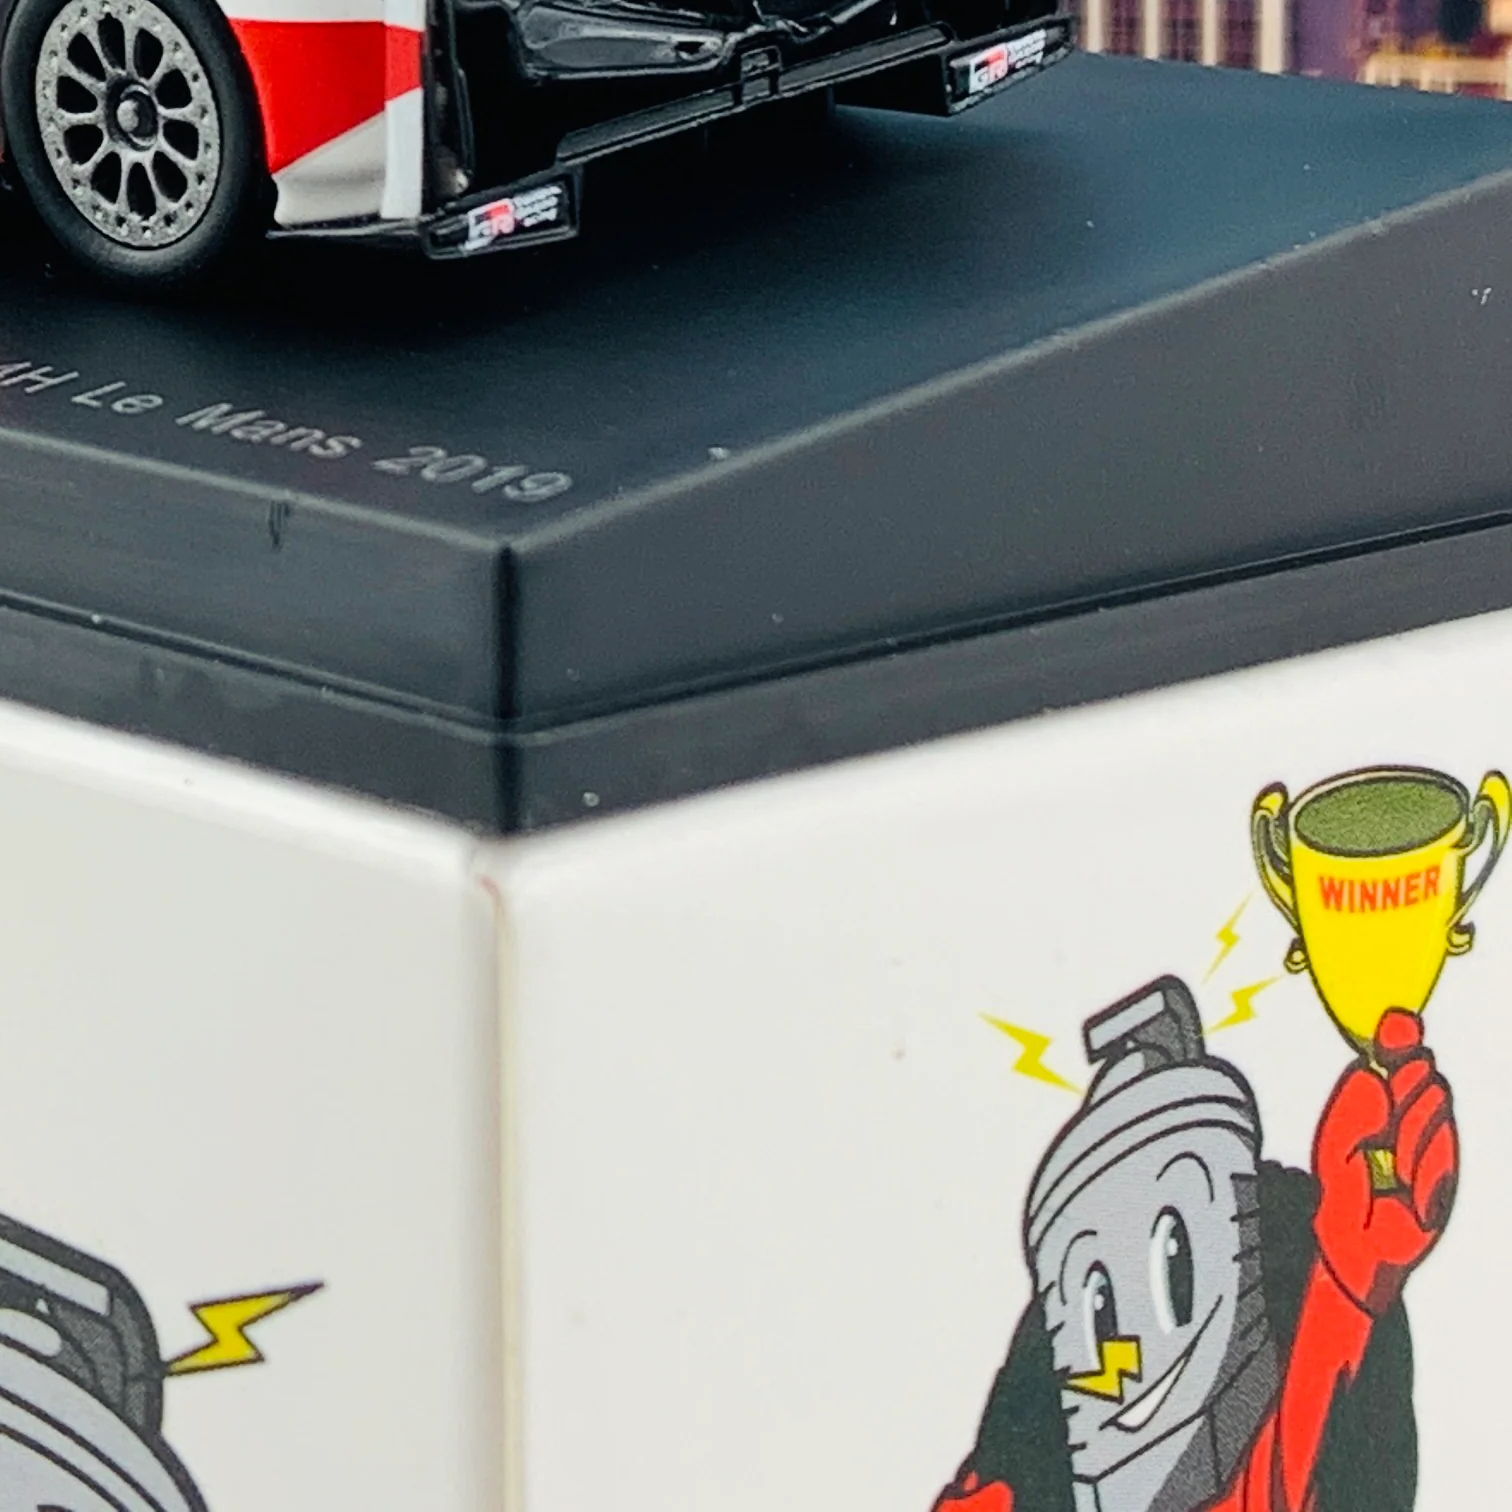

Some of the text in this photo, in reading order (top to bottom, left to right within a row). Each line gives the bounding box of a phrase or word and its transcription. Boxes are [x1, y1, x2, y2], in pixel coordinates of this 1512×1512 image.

[70, 380, 165, 415] Le
[174, 402, 363, 460] Mans
[371, 445, 574, 504] 2019
[1317, 864, 1441, 913] WINNER
